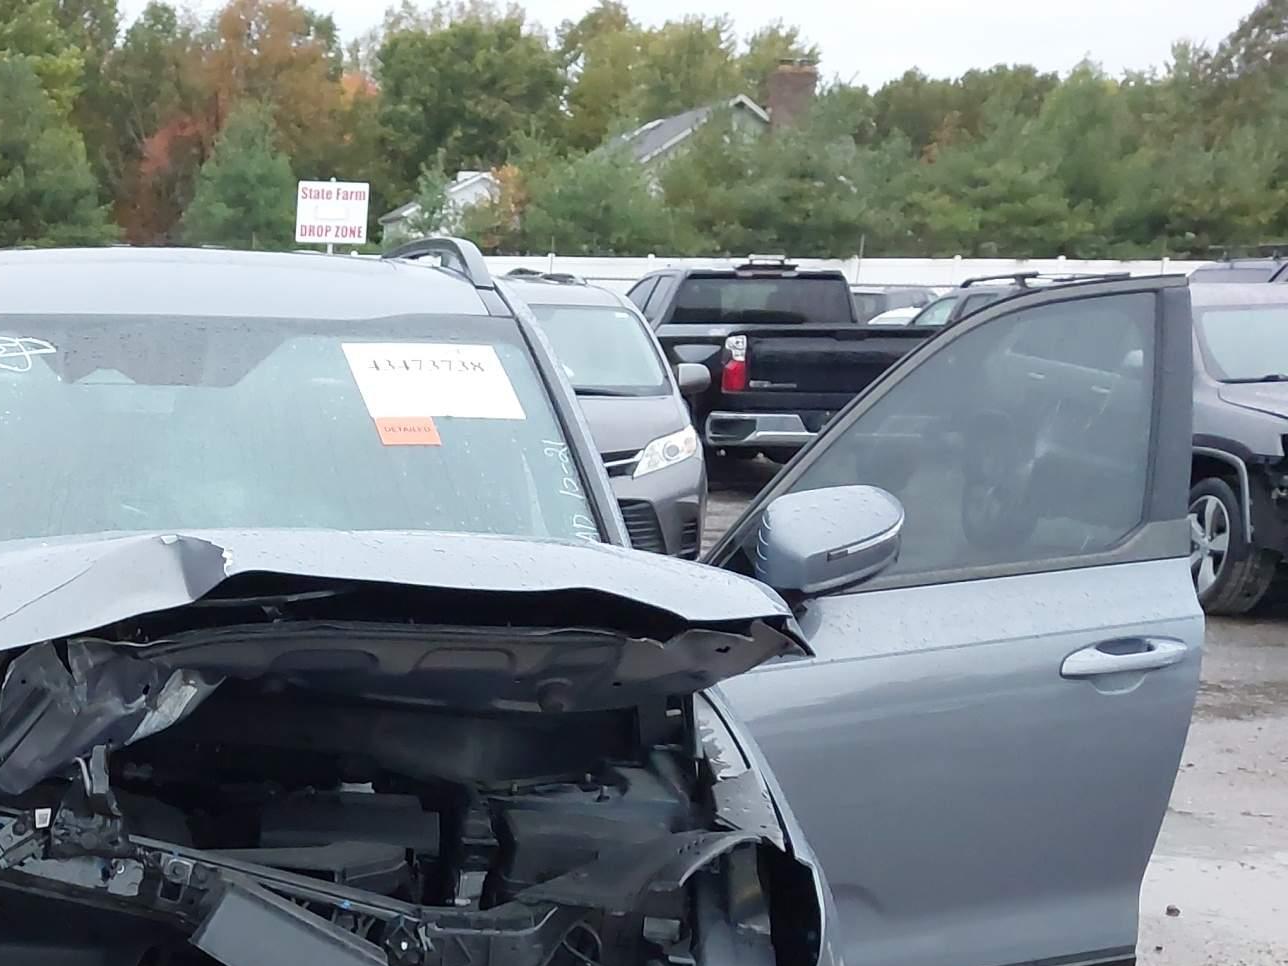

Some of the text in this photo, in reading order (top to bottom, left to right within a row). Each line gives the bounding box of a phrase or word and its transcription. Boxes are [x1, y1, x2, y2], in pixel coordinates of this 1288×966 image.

[301, 186, 366, 201] State Farm
[300, 224, 363, 238] DROP ZONE
